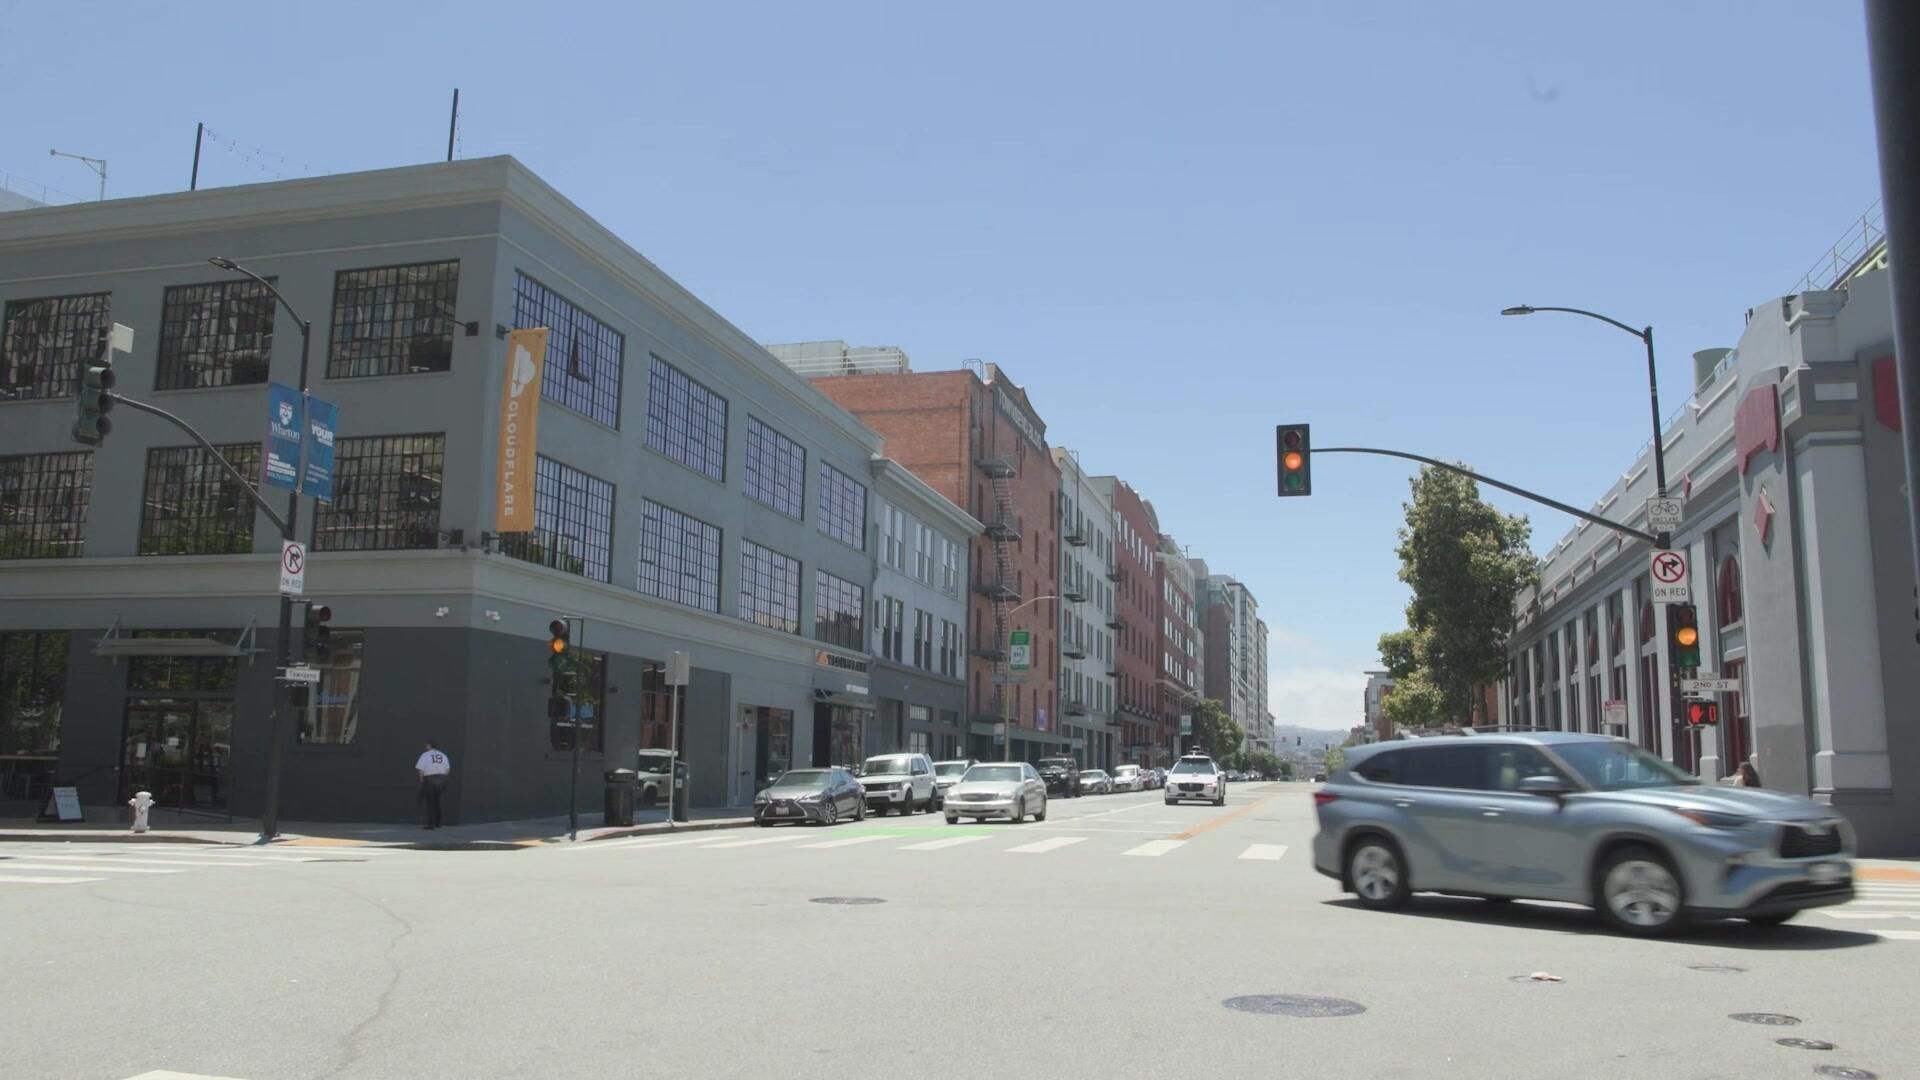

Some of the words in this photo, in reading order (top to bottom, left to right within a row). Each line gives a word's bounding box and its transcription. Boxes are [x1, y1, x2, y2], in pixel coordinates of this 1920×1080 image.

[311, 424, 334, 441] YOUR
[504, 401, 518, 516] CLOUDFLARE
[1655, 587, 1667, 596] ON
[1669, 587, 1687, 596] RED
[1692, 681, 1712, 689] 2ND
[1717, 681, 1728, 689] ST
[431, 753, 443, 764] 19
